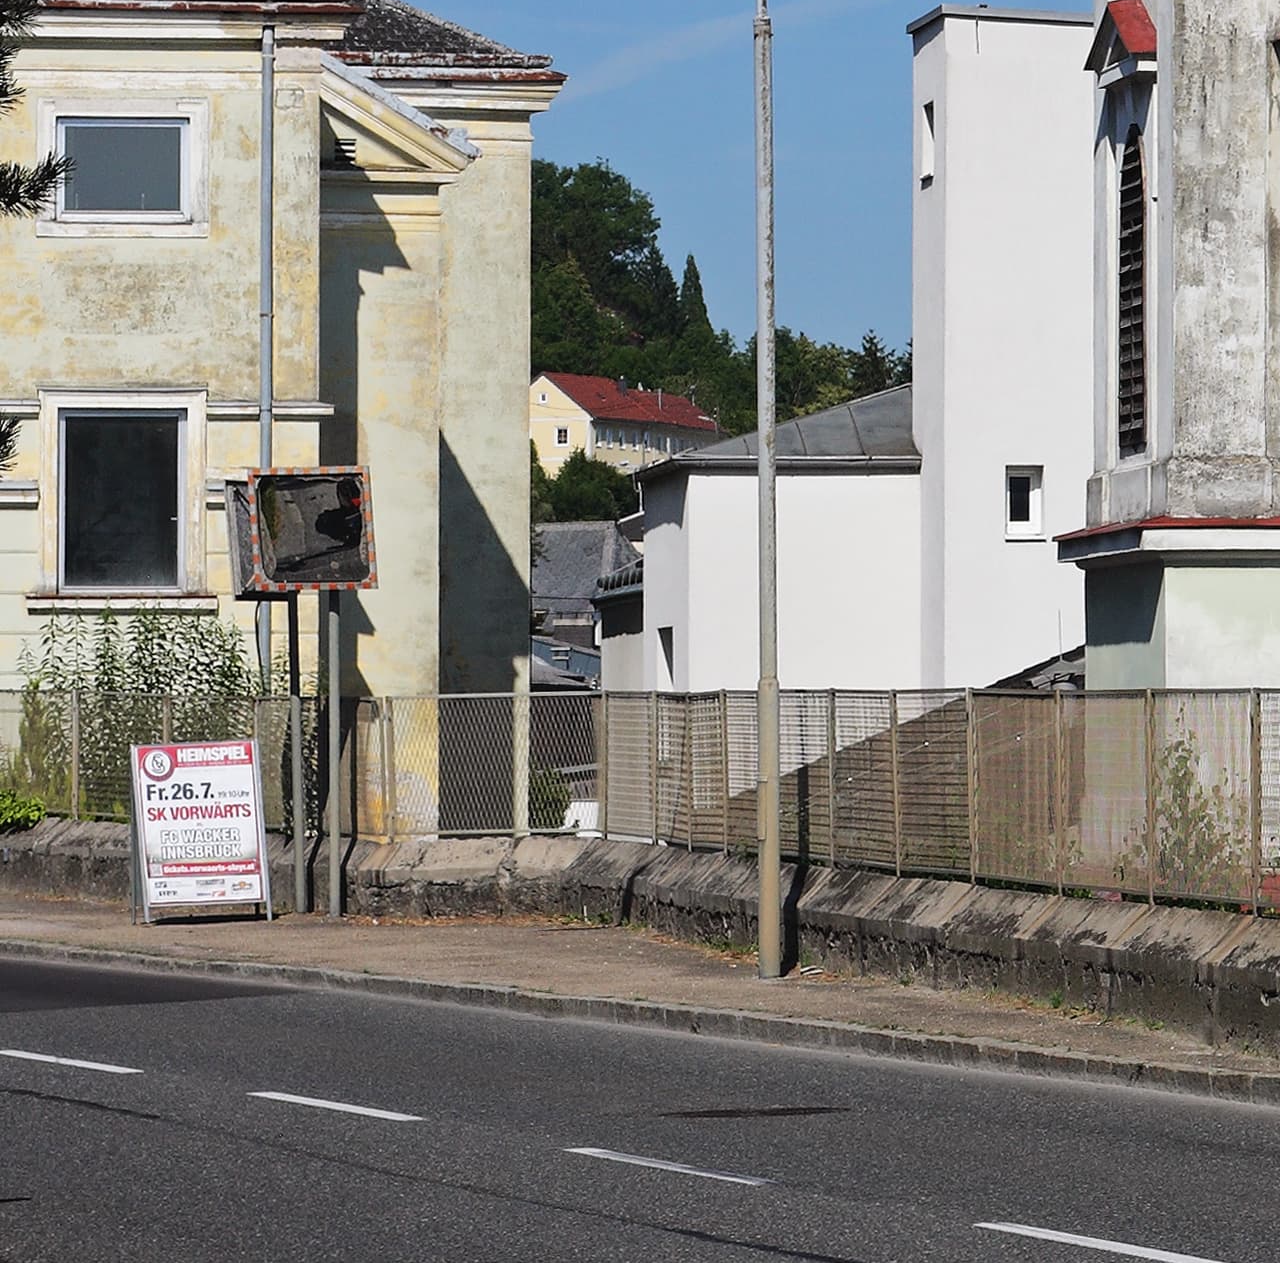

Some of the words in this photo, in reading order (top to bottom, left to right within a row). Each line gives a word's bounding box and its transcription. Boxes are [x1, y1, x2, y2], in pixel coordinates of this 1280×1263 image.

[176, 745, 249, 762] HEIMSPIEL
[147, 807, 167, 822] SK
[170, 802, 252, 820] VORWÄRTS
[161, 829, 179, 844] FC
[181, 827, 240, 843] WACKER
[161, 843, 242, 859] INNSBRUCK
